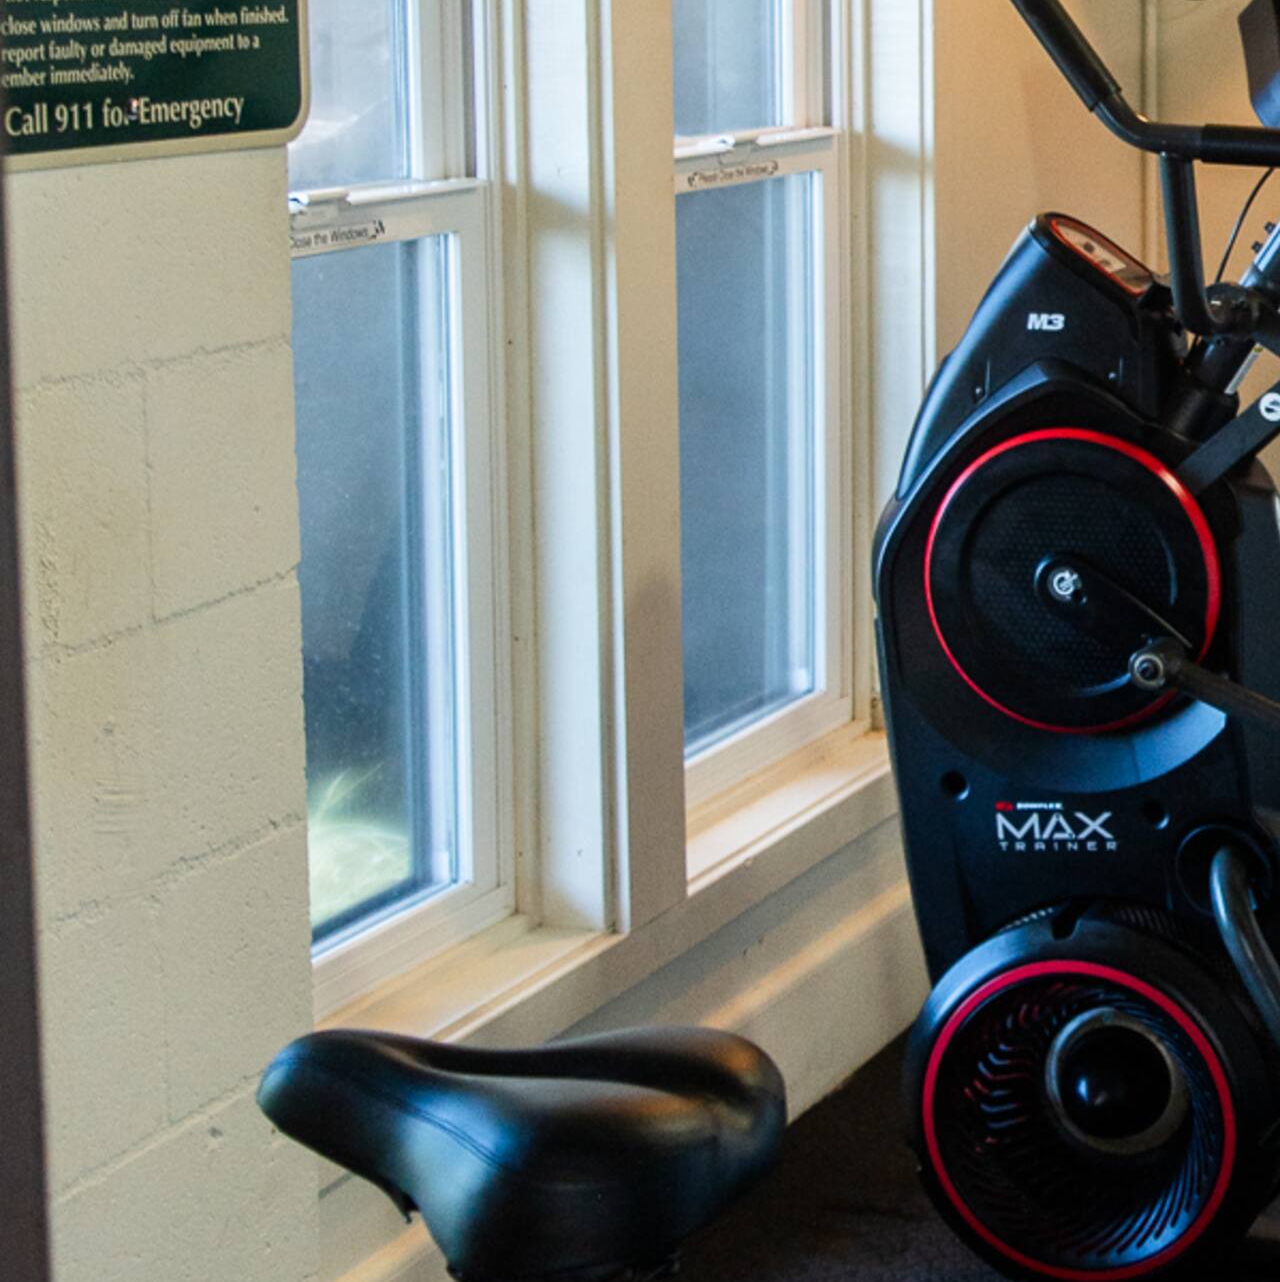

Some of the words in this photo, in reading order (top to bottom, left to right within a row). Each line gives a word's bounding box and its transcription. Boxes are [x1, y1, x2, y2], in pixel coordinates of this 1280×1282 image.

[40, 12, 101, 34] windows
[103, 10, 129, 31] and
[131, 13, 159, 30] turn
[161, 8, 180, 28] off
[182, 7, 202, 27] fan
[204, 7, 238, 26] when
[240, 5, 289, 24] finished.
[1, 43, 46, 68] report
[48, 39, 87, 63] faulty
[90, 43, 106, 58] or
[108, 35, 167, 61] damaged
[169, 33, 235, 59] equipment
[237, 33, 250, 50] to
[252, 35, 261, 49] a
[50, 59, 135, 86] immediately.
[4, 102, 48, 137] Call
[54, 102, 93, 134] 911
[139, 96, 244, 130] Emergency
[1026, 312, 1066, 331] M3
[995, 811, 1115, 840] MAX
[999, 840, 1118, 852] TRAINER
